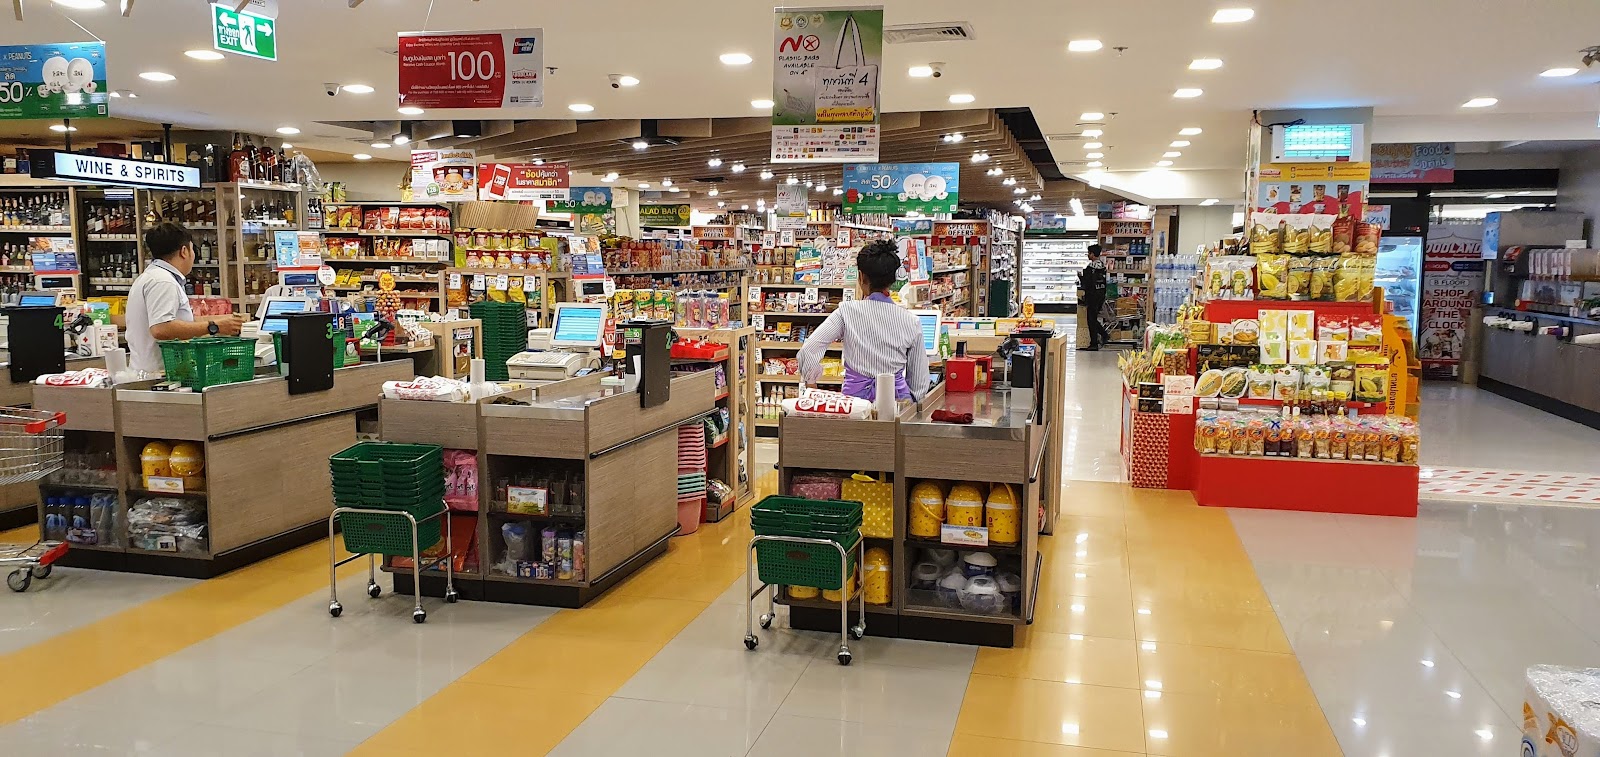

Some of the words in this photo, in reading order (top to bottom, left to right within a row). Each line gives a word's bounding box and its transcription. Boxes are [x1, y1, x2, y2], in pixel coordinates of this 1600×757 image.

[220, 34, 239, 46] EXIT
[8, 52, 32, 60] PEANUTS
[448, 51, 495, 81] 100
[5, 72, 16, 80] ลด
[859, 72, 869, 86] 4
[1415, 141, 1443, 156] Food
[1421, 159, 1446, 169] Drink
[75, 159, 113, 175] WINE
[120, 164, 129, 177] &
[135, 165, 185, 182] SPIRITS
[1426, 242, 1482, 254] OODLAND
[1433, 289, 1465, 297] SHOP
[1424, 300, 1473, 308] AROUND
[1436, 310, 1459, 319] THE
[53, 313, 64, 330] 4
[1428, 321, 1465, 330] CLOCK
[325, 322, 333, 339] 3
[665, 332, 671, 350] 2
[798, 399, 852, 413] OPEN
